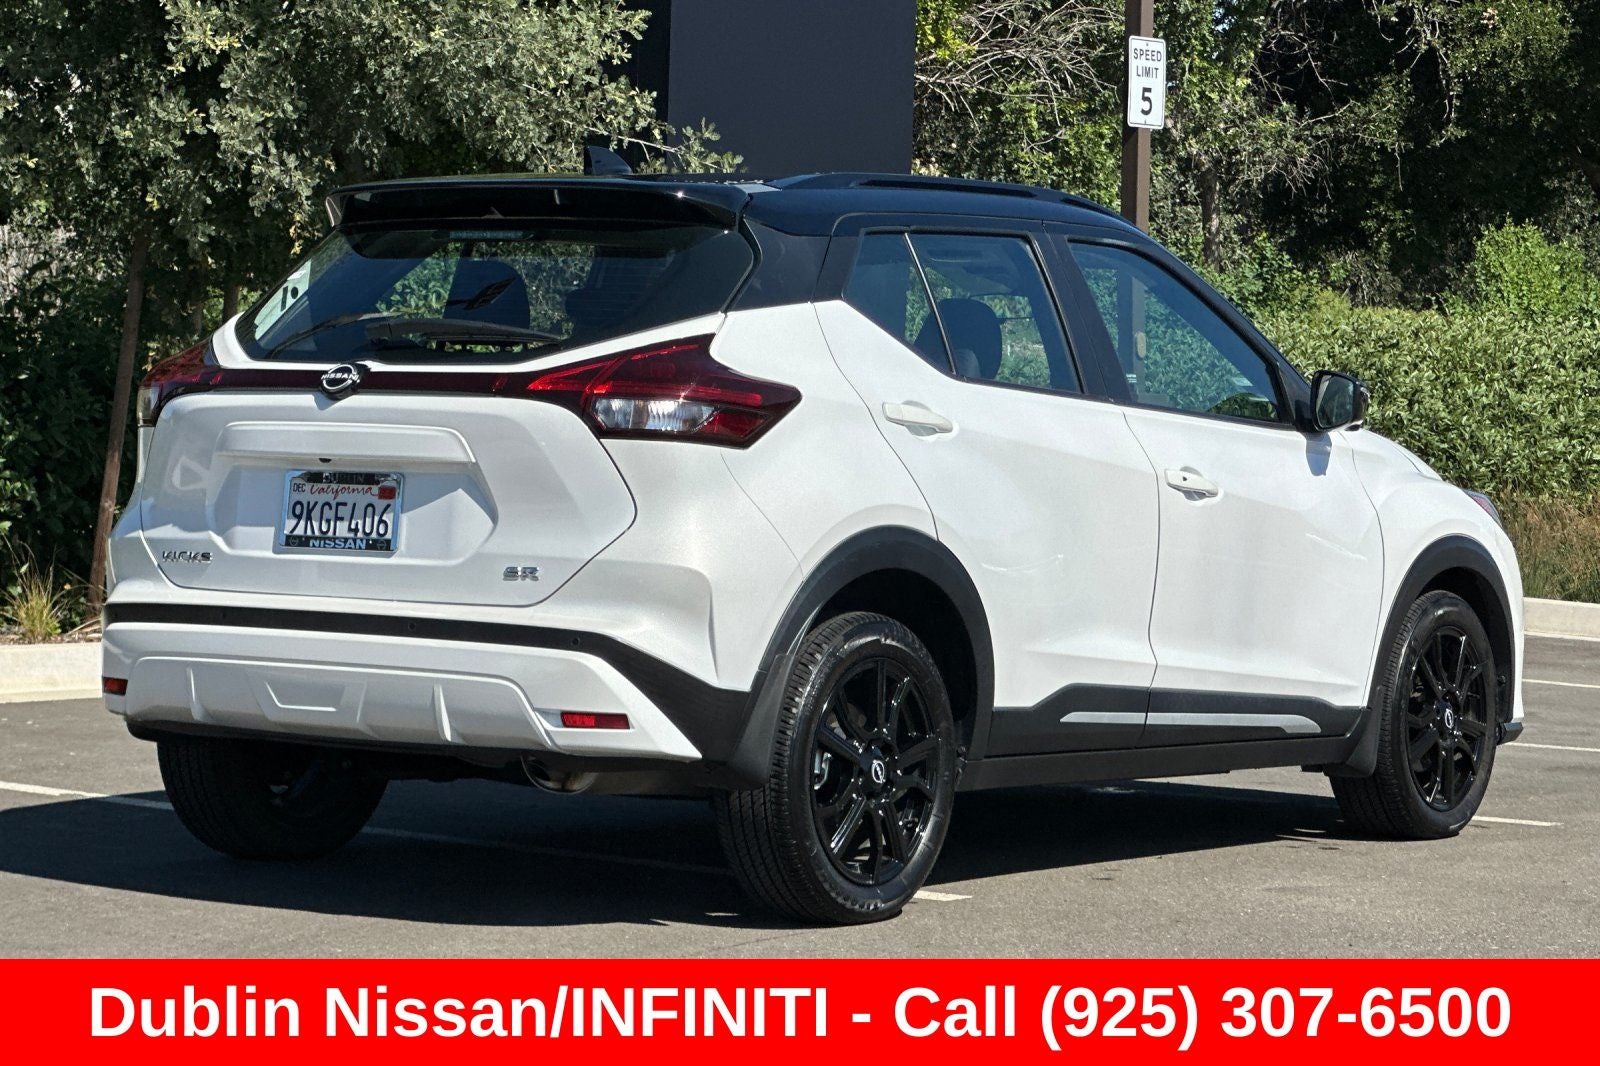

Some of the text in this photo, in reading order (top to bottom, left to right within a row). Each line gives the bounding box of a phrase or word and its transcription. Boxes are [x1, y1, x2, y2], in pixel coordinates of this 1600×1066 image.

[1133, 47, 1162, 62] SPEED
[1136, 65, 1159, 78] LIMIT
[1140, 86, 1153, 116] 5
[320, 372, 360, 381] NISSAN
[292, 482, 306, 493] DEC
[310, 484, 379, 500] California
[289, 500, 392, 538] 9KGF406
[309, 538, 367, 550] NISSAN
[162, 550, 212, 563] KICKS
[502, 566, 540, 582] SR
